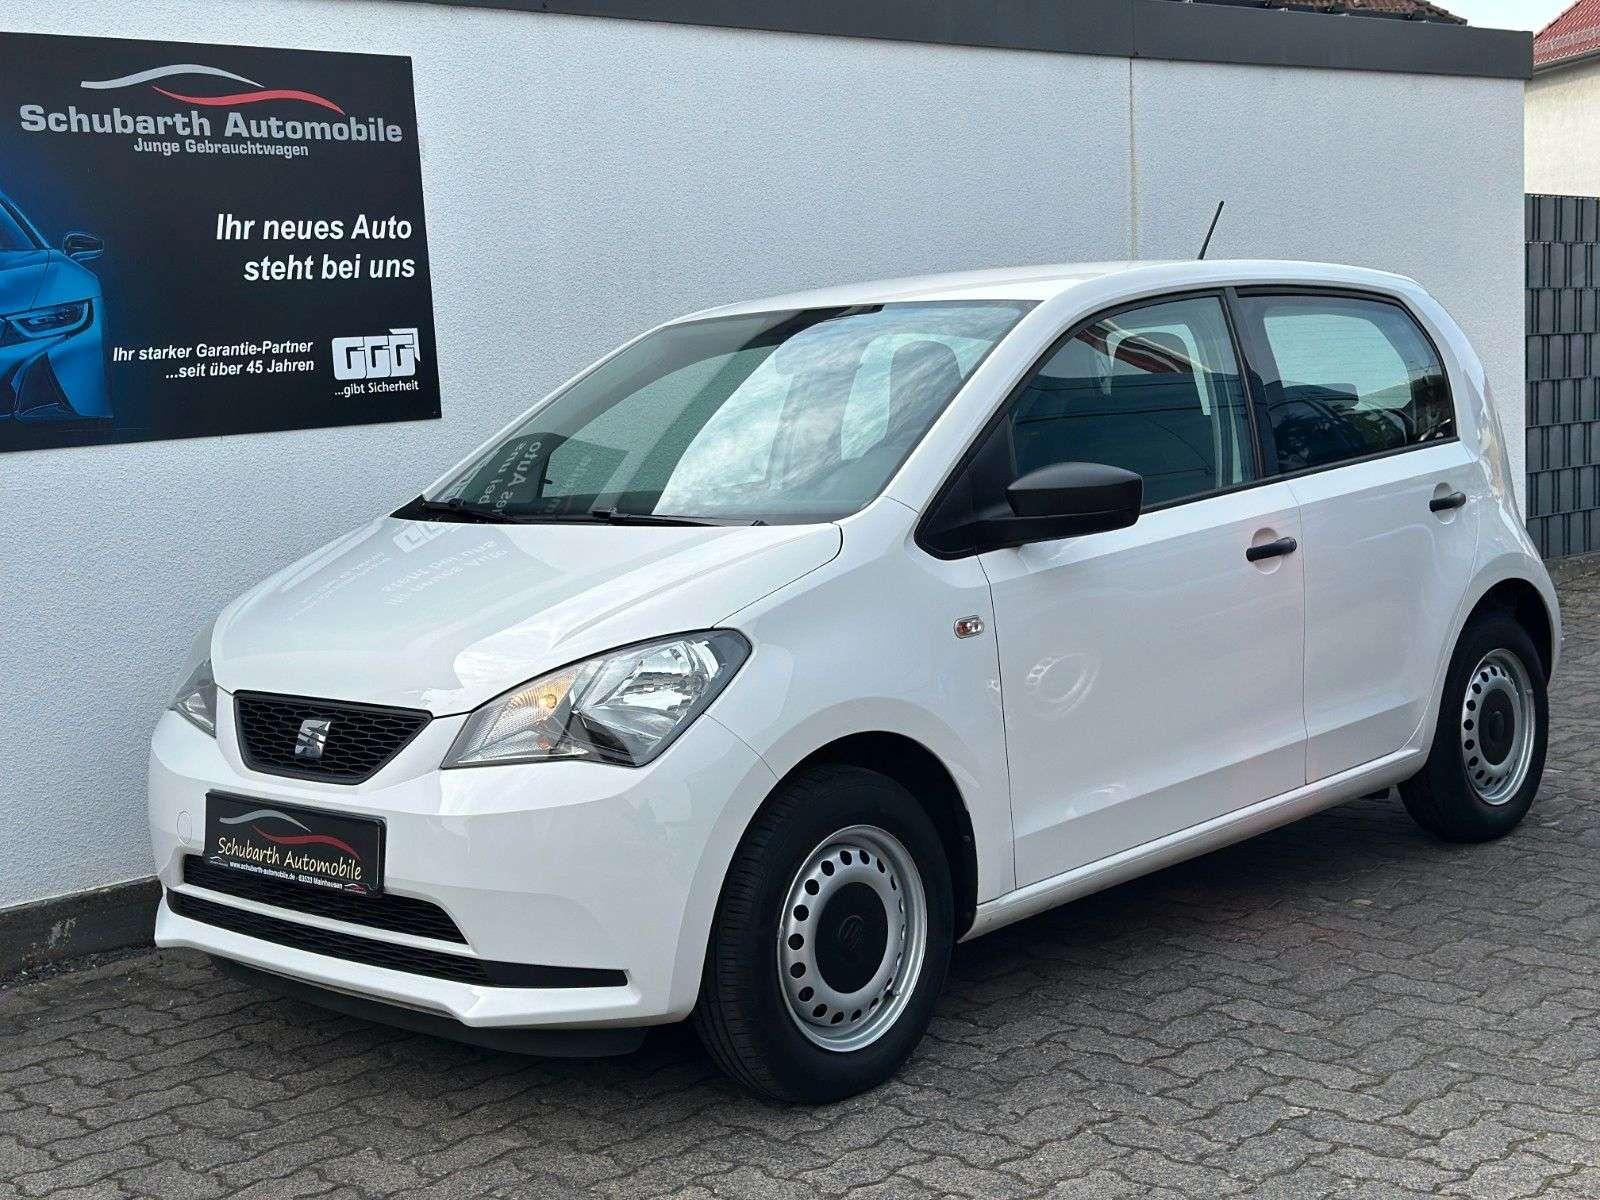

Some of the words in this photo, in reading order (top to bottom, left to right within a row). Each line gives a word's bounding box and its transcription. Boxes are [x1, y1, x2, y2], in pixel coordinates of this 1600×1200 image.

[20, 104, 211, 136] Schubarth
[224, 111, 403, 143] Automobile
[134, 138, 180, 154] Junge
[185, 138, 309, 158] Gebrauchtwagen
[216, 213, 255, 240] Ihr
[263, 219, 344, 240] neues
[351, 214, 412, 240] Auto
[244, 255, 314, 281] steht
[322, 254, 361, 279] bei
[370, 257, 415, 278] uns
[113, 346, 135, 362] Ihr
[139, 345, 192, 361] starker
[196, 340, 314, 358] Garantie-Partner
[165, 364, 207, 379] ...seit
[210, 361, 243, 376] über
[246, 359, 264, 374] 45
[267, 357, 314, 374] Jahren
[368, 379, 420, 394] Sicherheit
[218, 836, 280, 865] Schubarth
[283, 851, 362, 880] Automobile
